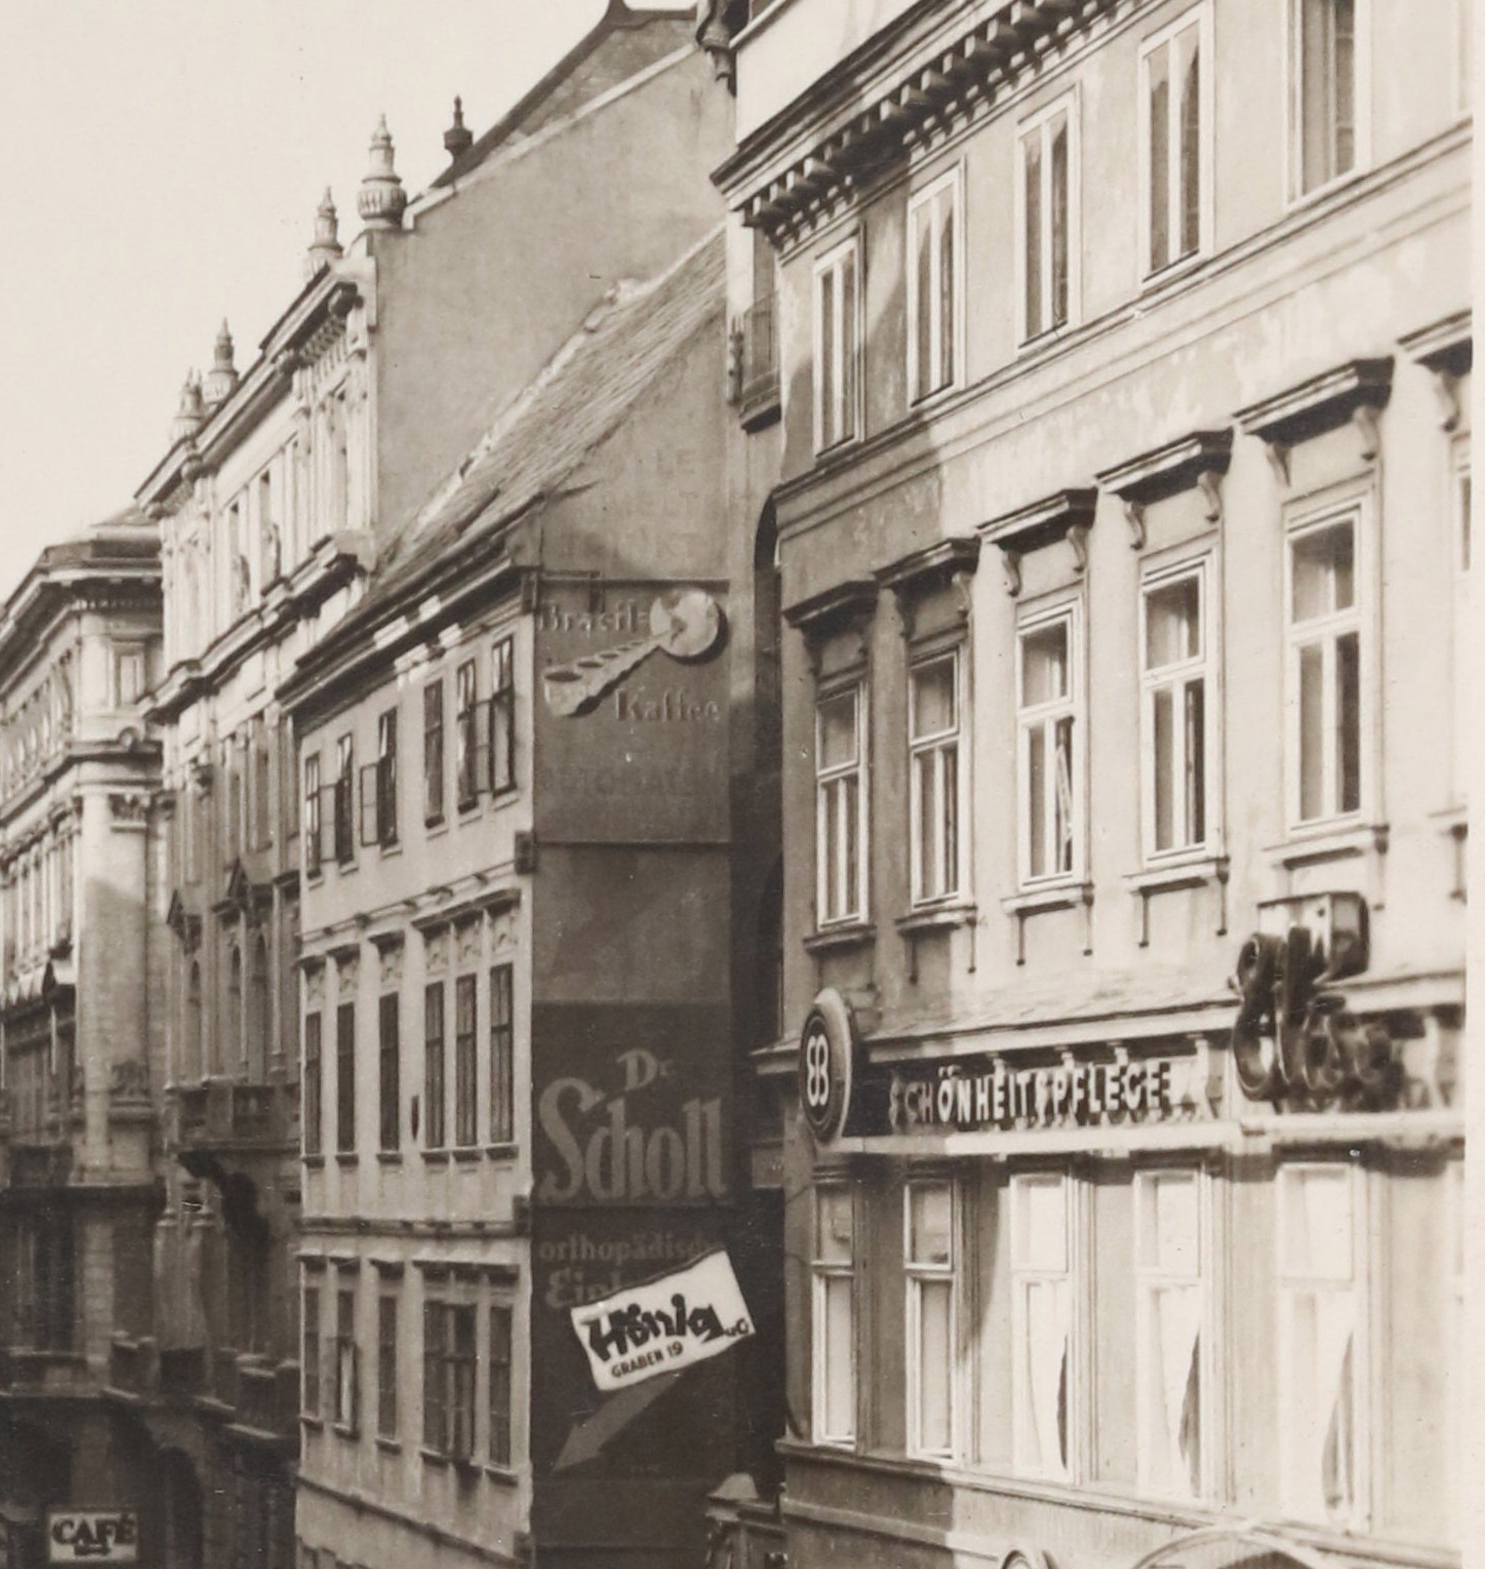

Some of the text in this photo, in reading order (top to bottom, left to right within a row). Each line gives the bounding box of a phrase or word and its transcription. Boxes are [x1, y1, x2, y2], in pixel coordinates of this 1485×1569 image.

[615, 687, 720, 721] Kaffee
[539, 1077, 726, 1201] Scholl
[611, 1341, 684, 1378] GRABEN 19
